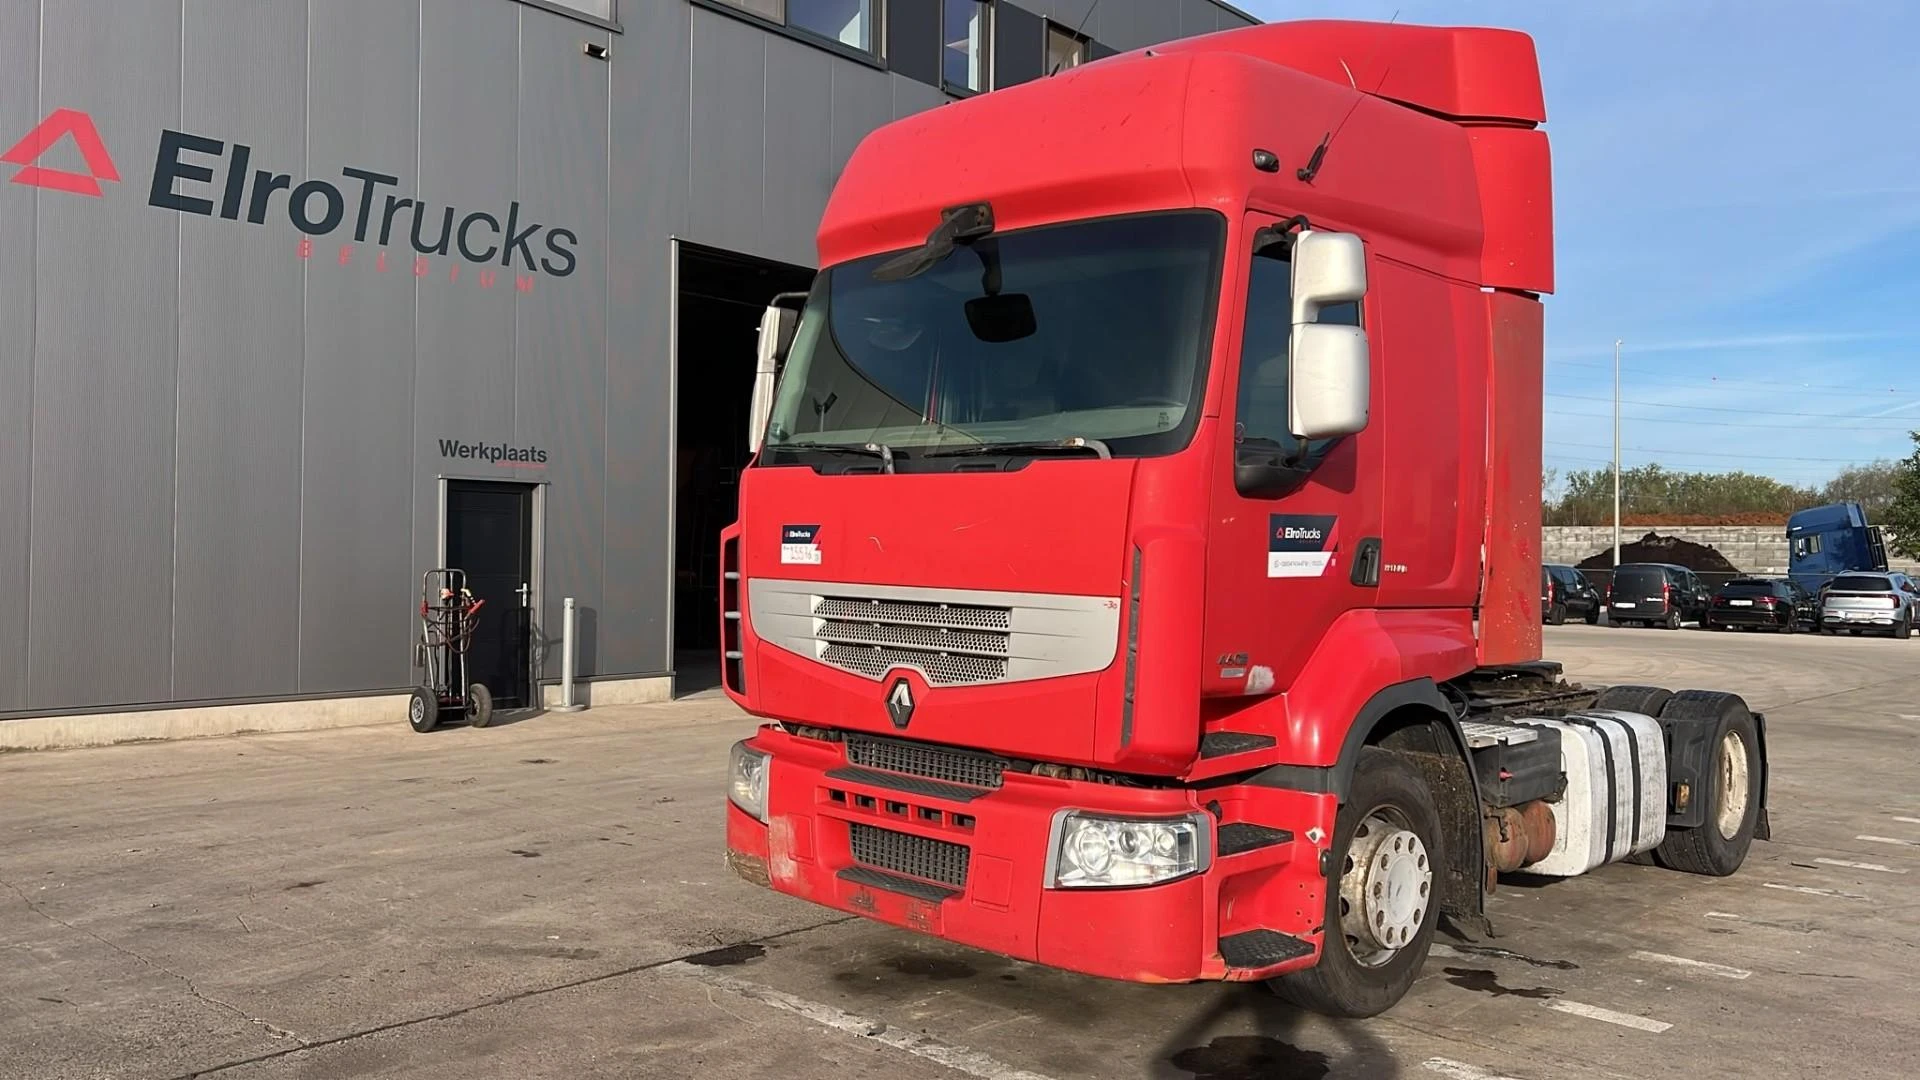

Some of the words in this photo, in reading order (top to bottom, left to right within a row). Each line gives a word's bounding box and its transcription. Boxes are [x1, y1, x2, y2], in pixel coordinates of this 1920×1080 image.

[148, 128, 578, 278] ElroTrucks
[438, 439, 548, 463] Werkplaats
[1284, 527, 1321, 539] ElroTrucks
